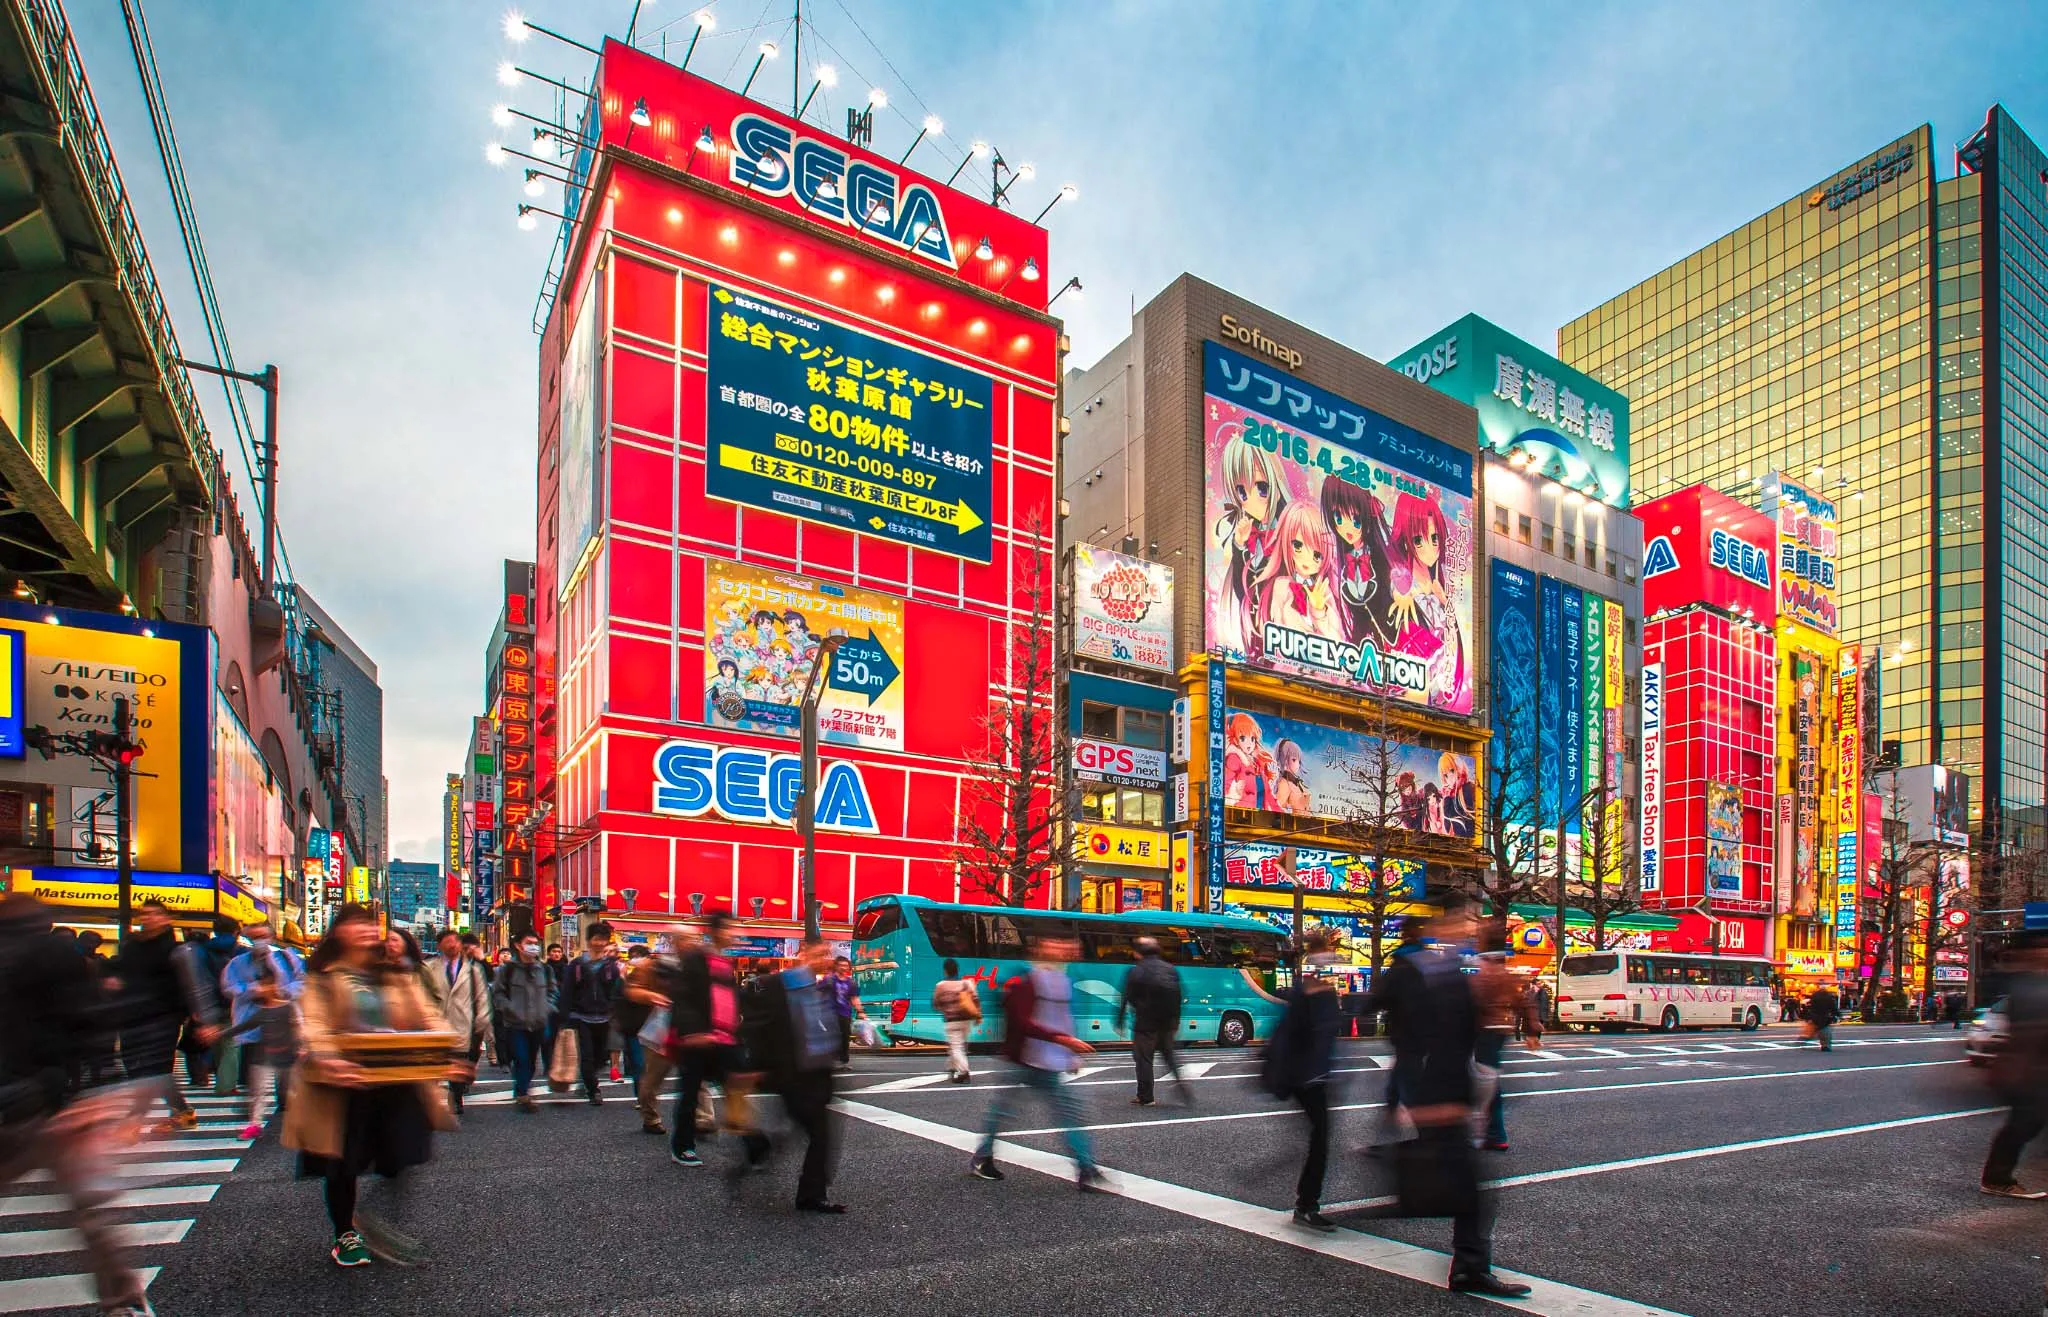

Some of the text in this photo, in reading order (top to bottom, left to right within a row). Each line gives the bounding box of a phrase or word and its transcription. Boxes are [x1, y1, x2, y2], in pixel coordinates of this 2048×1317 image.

[730, 113, 957, 270] SEGA
[1221, 314, 1303, 370] Sofmap
[720, 312, 985, 410] 総合マンションギャラリー
[806, 366, 913, 421] 秋葉原館
[1219, 358, 1366, 441] ソフマップ
[800, 440, 937, 490] 0120-009-897
[1378, 431, 1464, 480] アミューズメント館
[1396, 475, 1428, 501] SALE
[888, 522, 937, 543] 住友不動産
[1709, 528, 1771, 590] SEGA
[1782, 543, 1836, 589] 高額買取
[1505, 571, 1523, 585] Hey
[1083, 616, 1103, 632] BIG
[836, 645, 882, 662] ここから
[41, 662, 166, 687] SHISEIDO
[837, 659, 884, 686] 50m
[1645, 669, 1658, 717] AKKY
[57, 707, 152, 729] Kanbo
[820, 718, 876, 737] 秋葉原新館
[831, 708, 886, 726] クラブセガ
[1076, 742, 1134, 773] GPS
[1644, 732, 1658, 802] Tax-free
[1113, 776, 1159, 789] 0120-915-047
[1135, 767, 1159, 777] next
[652, 740, 880, 834] SEGA
[1780, 799, 1790, 824] GAME
[1642, 805, 1657, 846] Shop
[1117, 840, 1150, 857] 松屋
[331, 858, 340, 885] KFC
[33, 887, 119, 902] Matsumot
[1175, 881, 1184, 912] 松屋
[1727, 921, 1744, 948] SEGA
[1649, 986, 1735, 1002] YUNAGI
